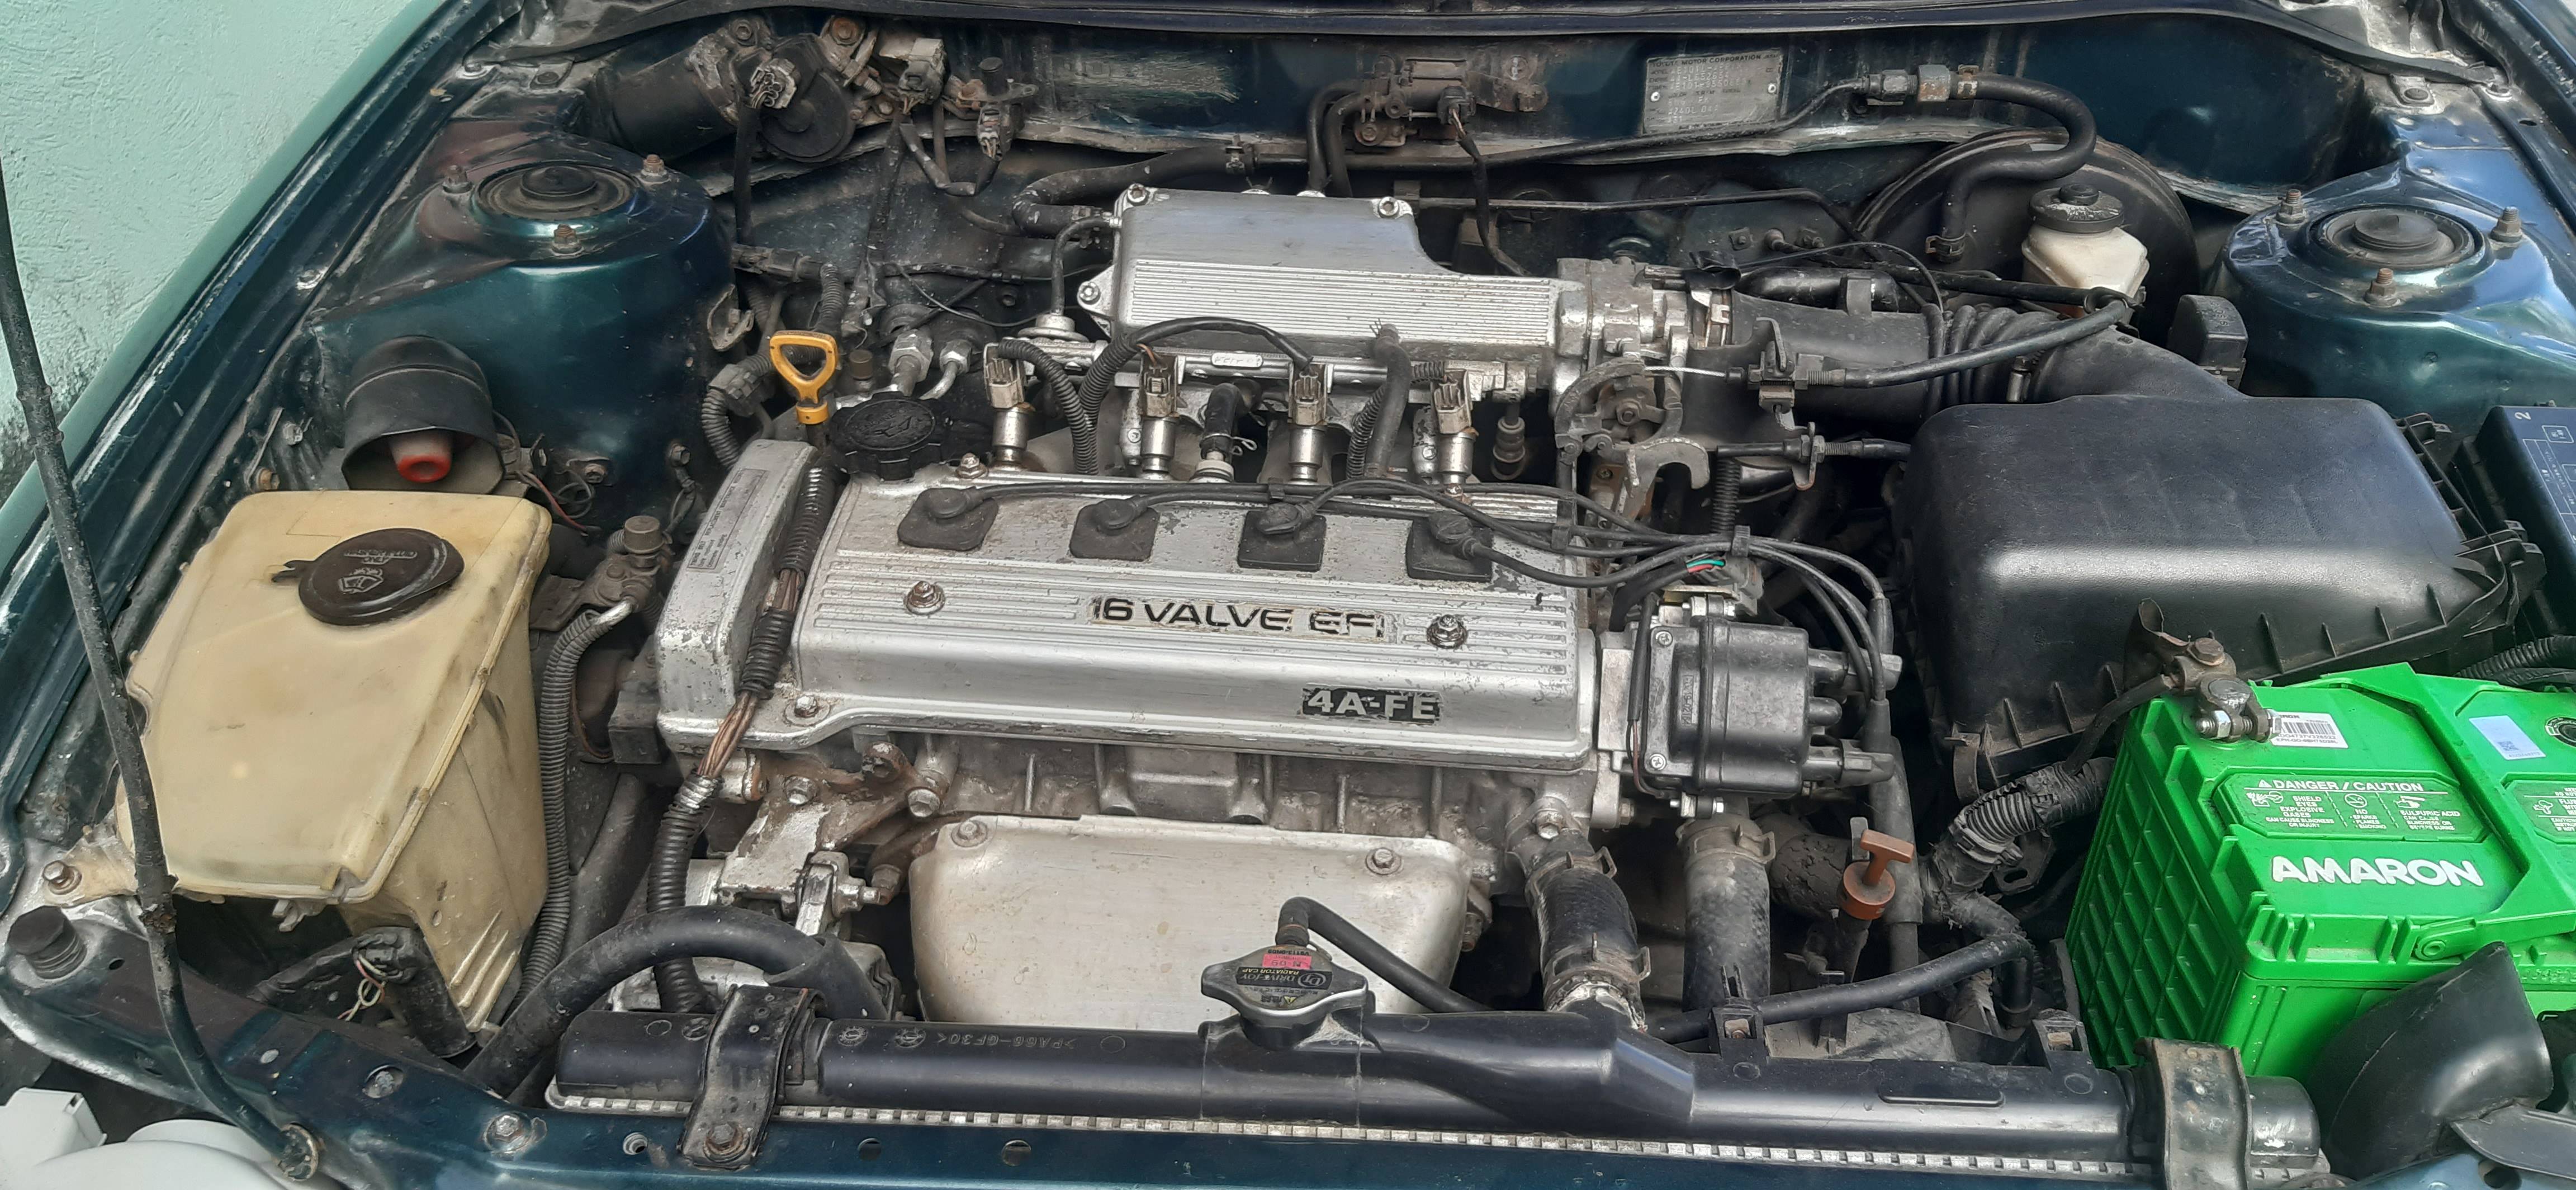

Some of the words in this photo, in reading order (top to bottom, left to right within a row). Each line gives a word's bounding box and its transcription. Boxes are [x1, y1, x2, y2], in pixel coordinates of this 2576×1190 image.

[1709, 54, 1761, 63] CORPORATION
[2515, 412, 2532, 420] 2
[1144, 602, 1293, 631] VALVE
[1309, 611, 1385, 638] EFI
[1308, 690, 1439, 720] 4A-FE
[2273, 780, 2339, 790] DANGER
[2353, 782, 2424, 791] CAUTION
[2272, 856, 2484, 887] AMARON
